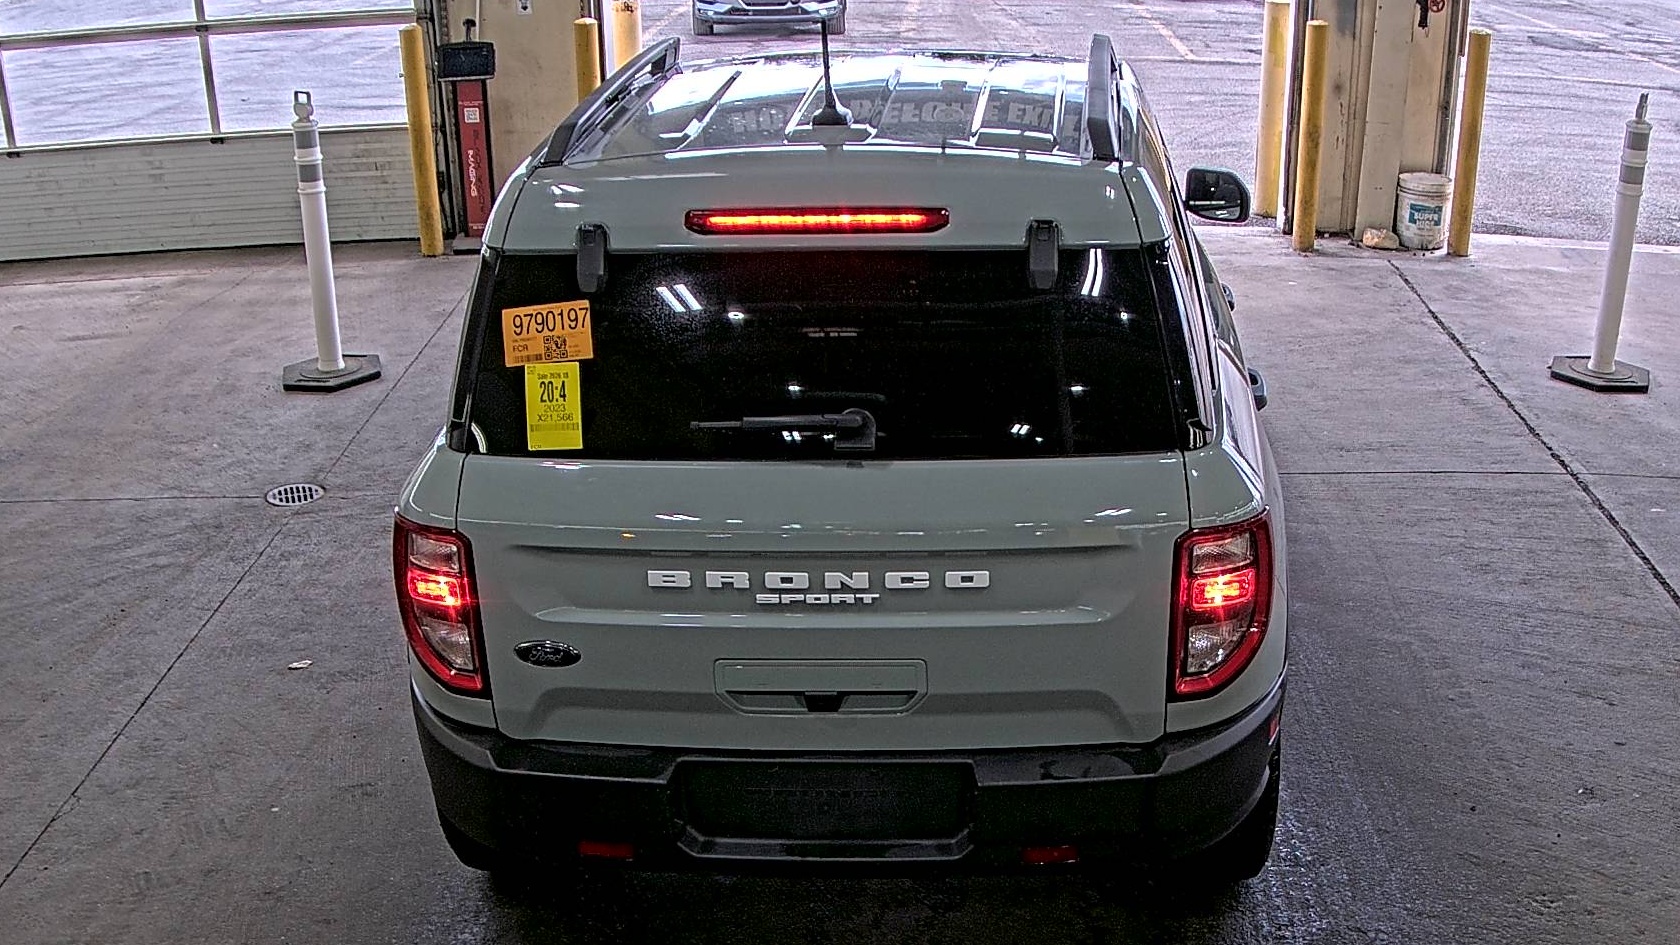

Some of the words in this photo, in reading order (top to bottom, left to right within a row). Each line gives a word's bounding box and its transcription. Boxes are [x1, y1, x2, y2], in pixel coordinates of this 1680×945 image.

[512, 307, 589, 336] 9790197
[540, 380, 566, 403] 20:4
[543, 404, 566, 413] 2023
[647, 570, 991, 590] BRONCO
[755, 593, 880, 604] SPORT
[528, 647, 564, 662] Ford
